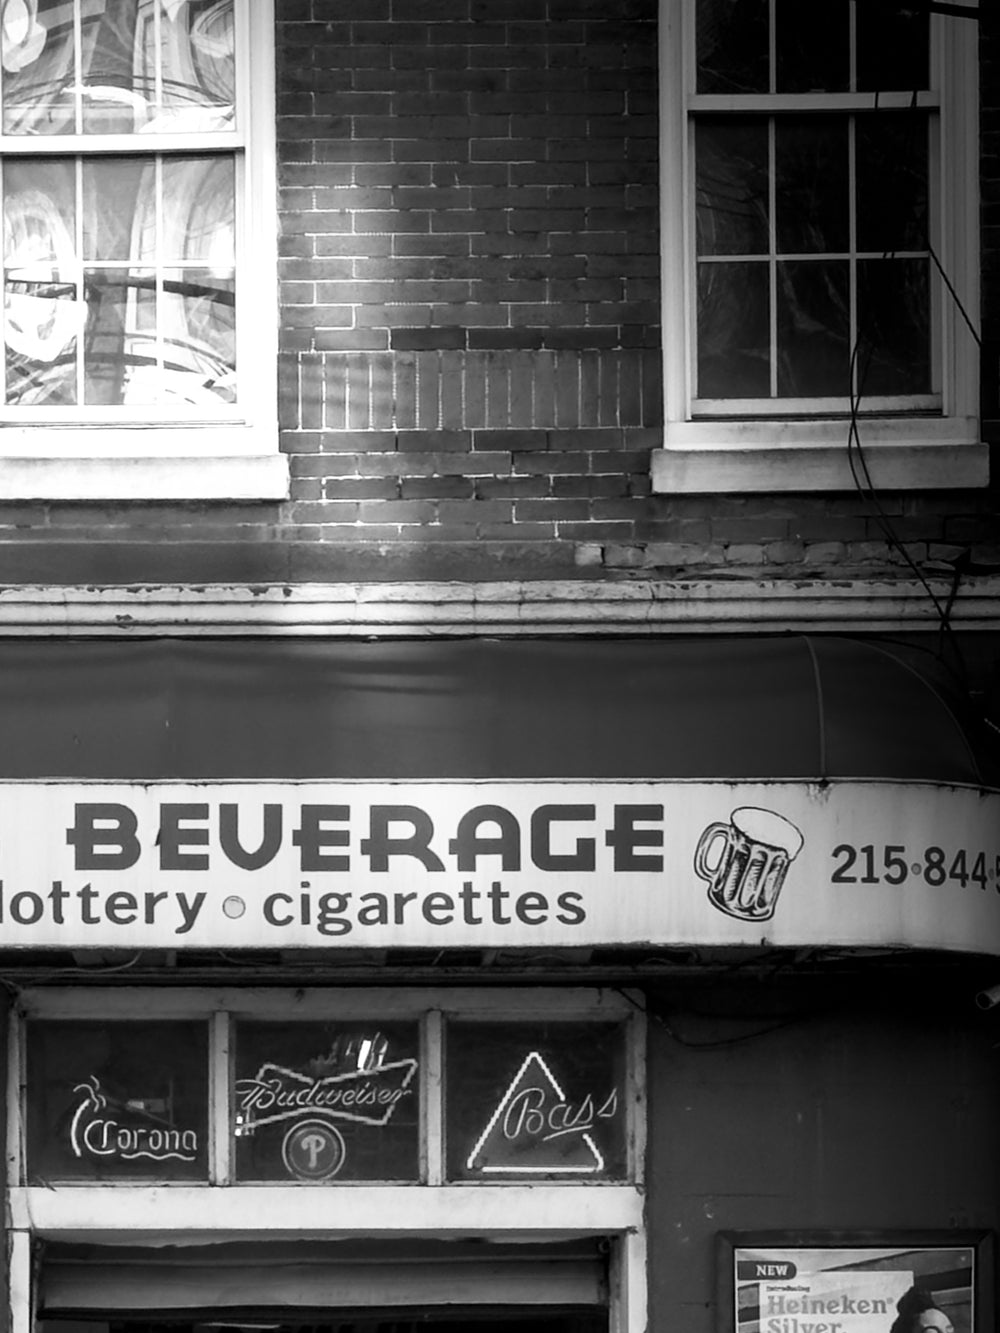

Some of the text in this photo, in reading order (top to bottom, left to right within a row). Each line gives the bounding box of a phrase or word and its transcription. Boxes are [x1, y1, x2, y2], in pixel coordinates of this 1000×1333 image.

[66, 802, 665, 873] BEVERAGE
[262, 881, 587, 936] cigarettes
[235, 1078, 413, 1110] Budweiser
[502, 1087, 618, 1140] Bass
[84, 1120, 198, 1156] Corona
[755, 1264, 789, 1277] NEW
[767, 1295, 887, 1315] Heineken
